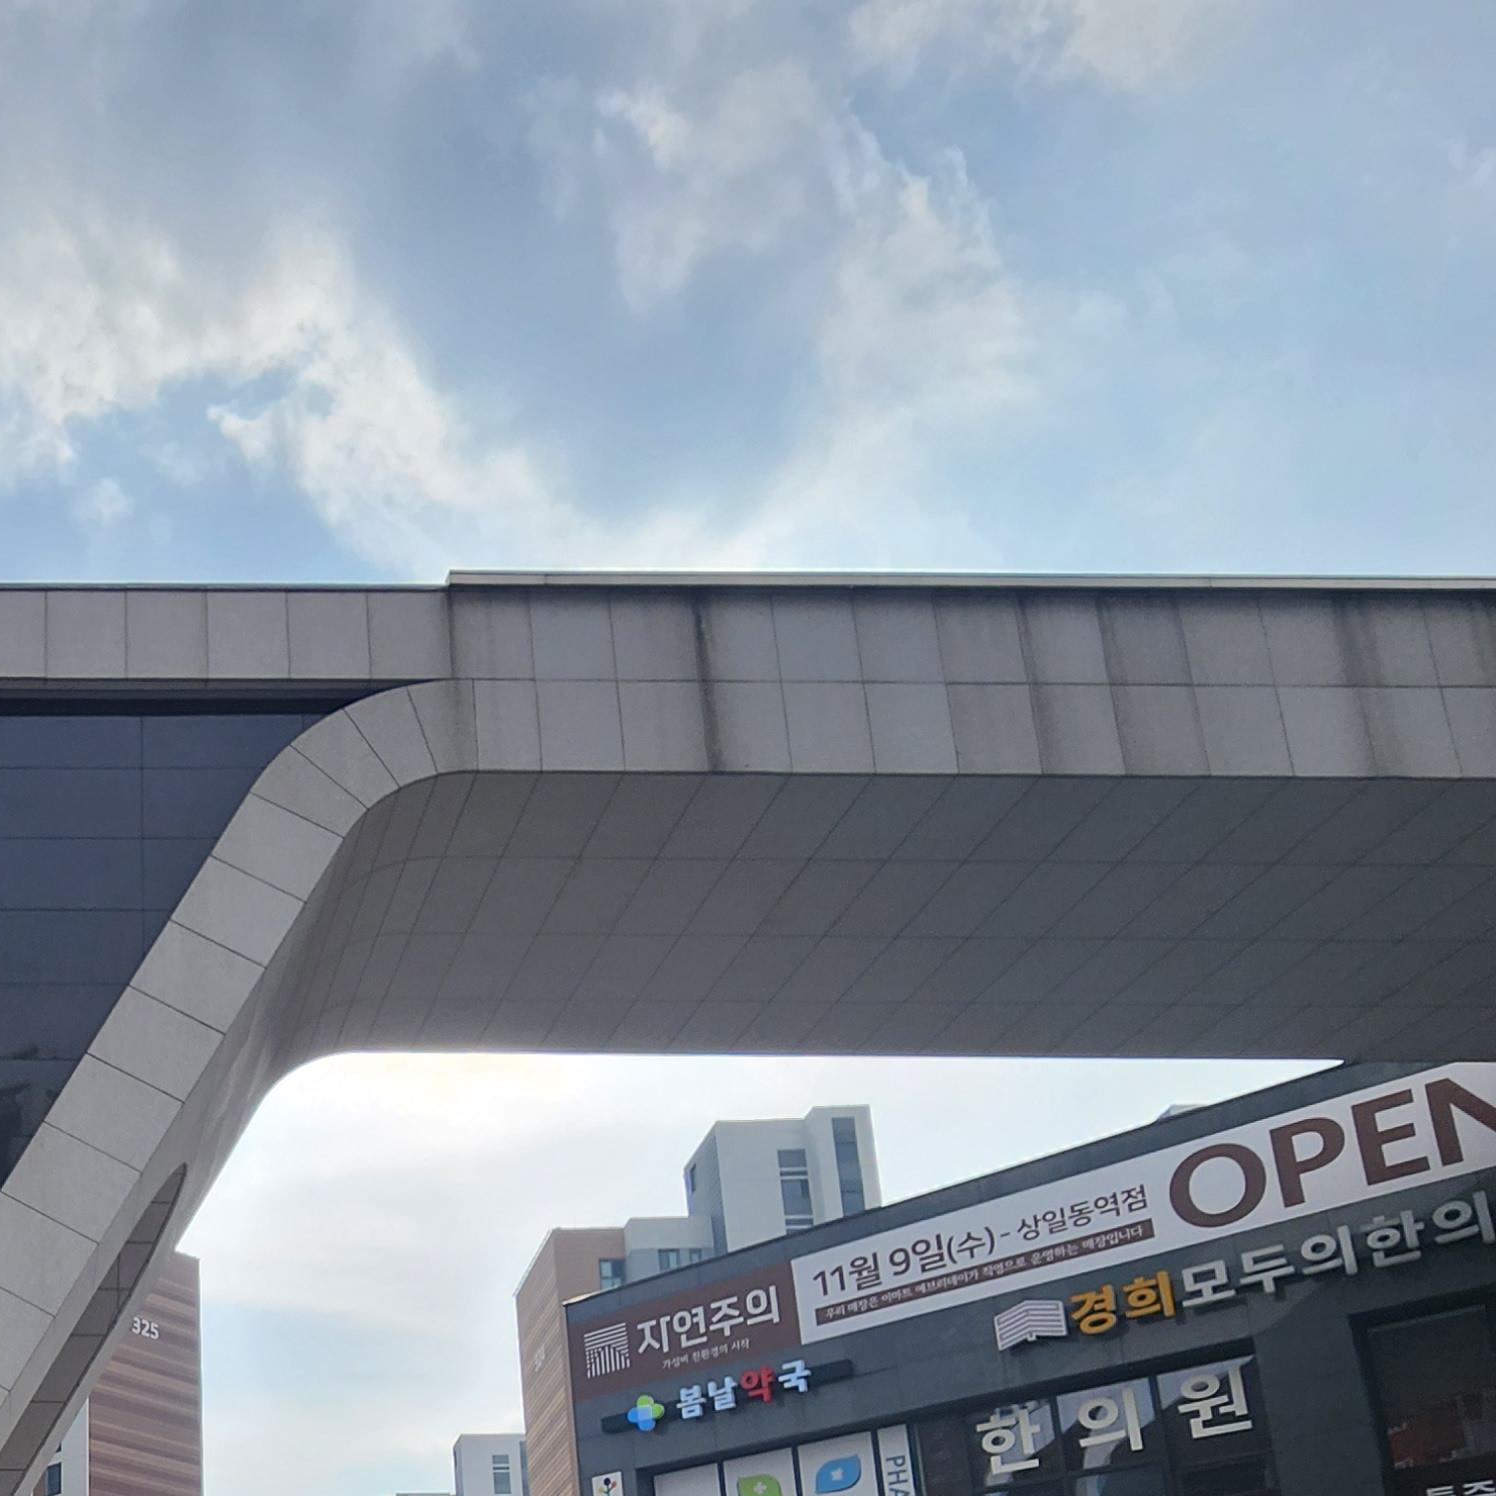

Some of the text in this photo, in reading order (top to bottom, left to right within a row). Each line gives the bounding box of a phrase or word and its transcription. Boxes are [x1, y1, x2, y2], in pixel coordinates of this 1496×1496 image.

[812, 1252, 883, 1297] 11월
[1017, 1183, 1148, 1241] 상일동역점
[132, 1316, 159, 1340] 325
[636, 1285, 780, 1353] 자연주의
[676, 1359, 811, 1420] 봄날약국
